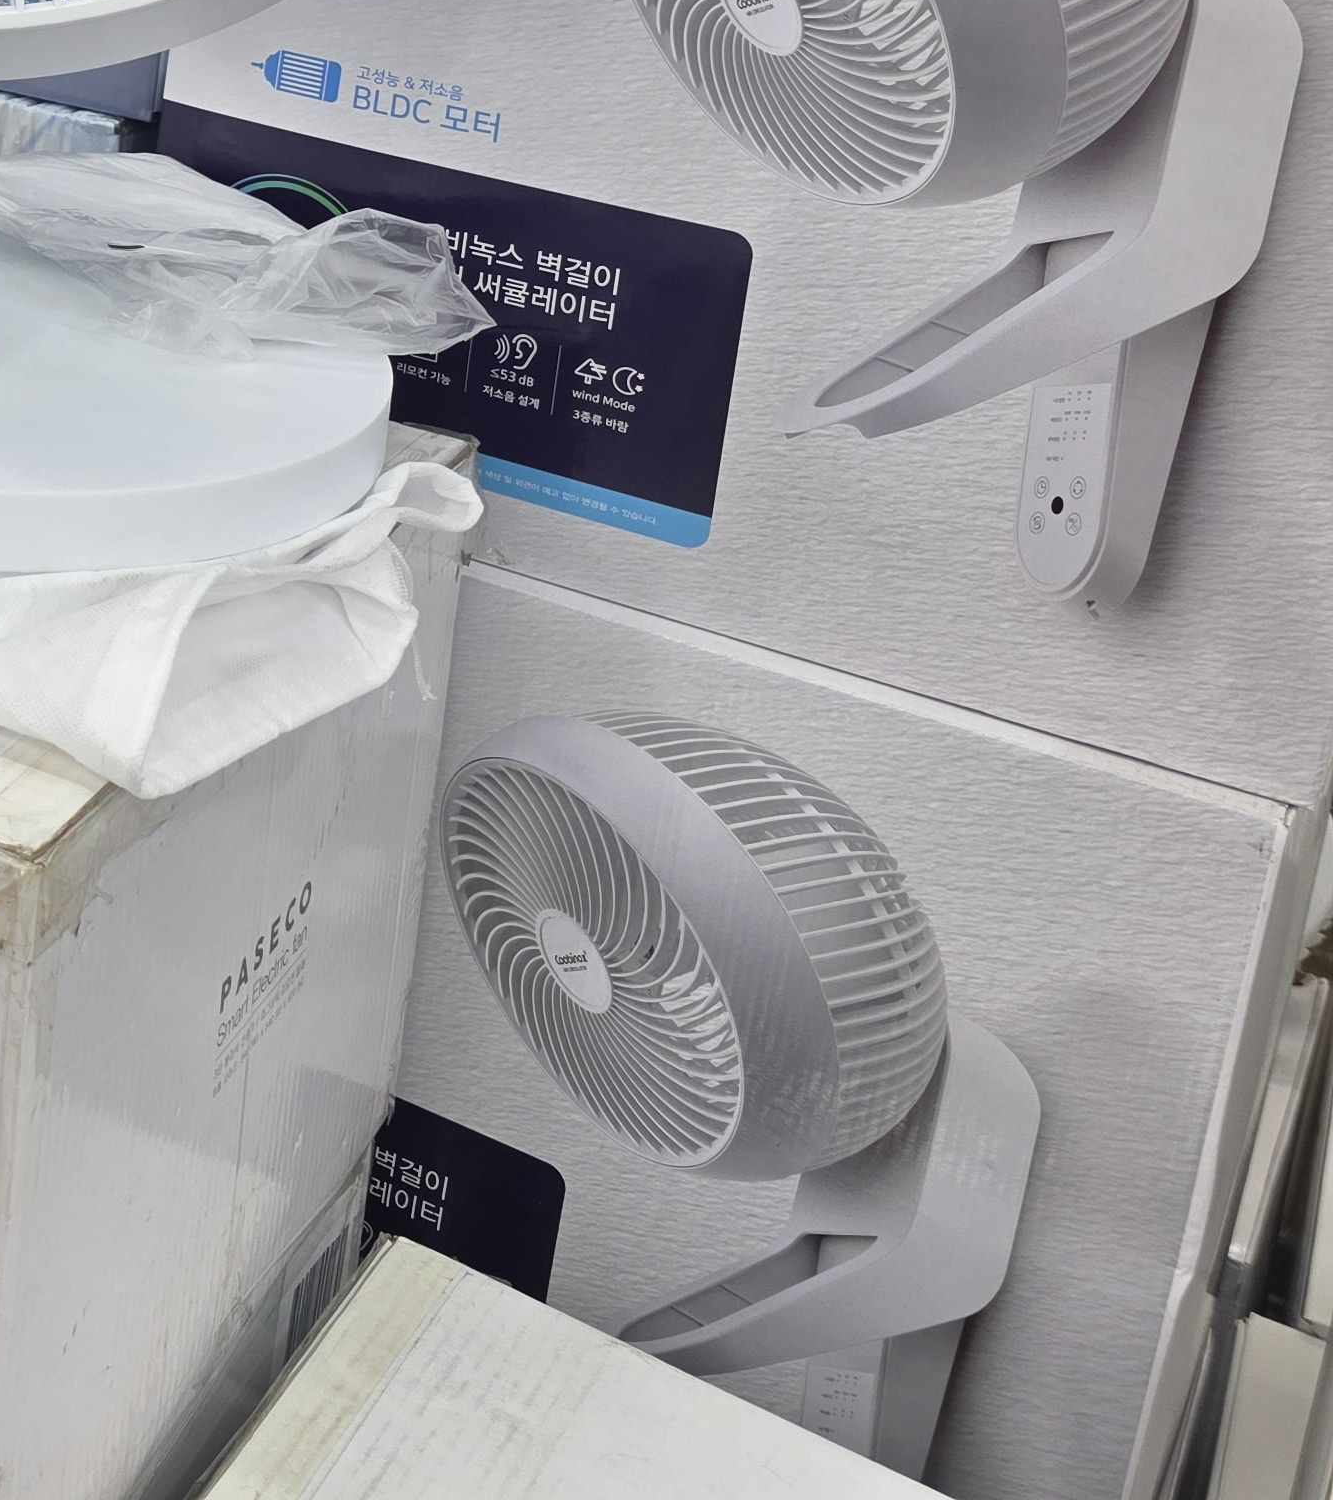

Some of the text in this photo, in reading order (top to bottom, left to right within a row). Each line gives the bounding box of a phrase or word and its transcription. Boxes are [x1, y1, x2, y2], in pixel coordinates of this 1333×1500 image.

[355, 64, 465, 102] 고성능 & 저소음
[351, 85, 501, 143] BLDC 모터
[536, 250, 621, 296] 벽걸이
[473, 270, 616, 330] 써큘레이터
[396, 362, 452, 387] 리모컨 기능
[518, 374, 535, 388] dB
[482, 385, 540, 411] 저소음 설계
[571, 389, 635, 414] wind Mode
[572, 409, 629, 435] 3종류 바람
[218, 879, 313, 1016] PASECO
[215, 925, 309, 1048] Smart Electric fan
[373, 1145, 451, 1204] 벽걸이
[368, 1178, 445, 1233] 레이터
